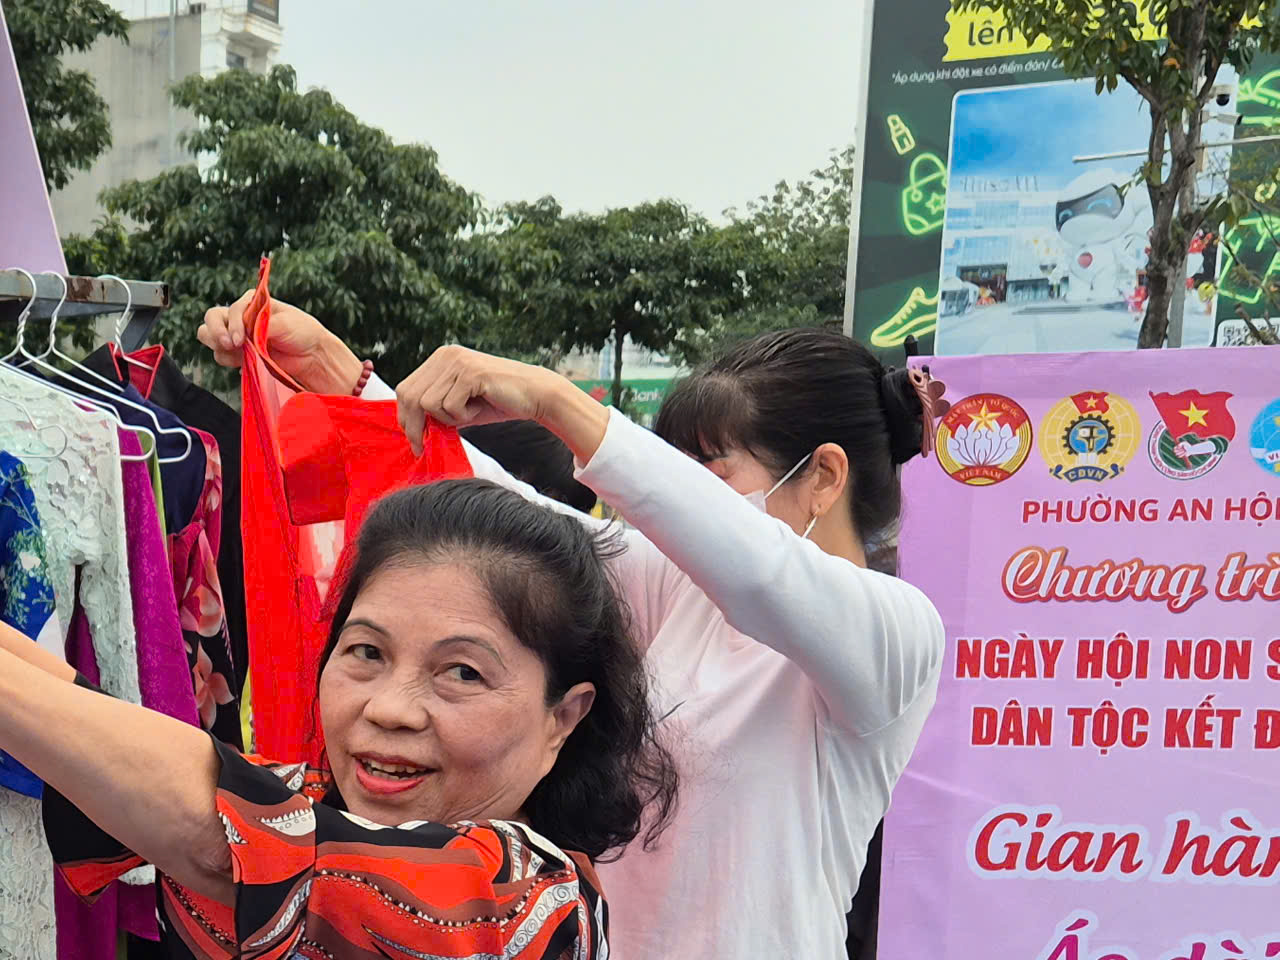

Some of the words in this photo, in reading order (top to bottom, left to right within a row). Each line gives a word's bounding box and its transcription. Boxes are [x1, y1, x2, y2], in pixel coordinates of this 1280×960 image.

[967, 20, 1014, 47] lên
[1022, 493, 1159, 523] PHƯỜNG
[1168, 498, 1213, 522] AN
[1003, 547, 1206, 613] Chương
[956, 633, 1064, 679] NGÀY
[1076, 632, 1150, 687] HỘI
[1164, 639, 1252, 680] NON
[972, 699, 1053, 746] DÂN
[1067, 700, 1149, 755] TỘC
[1164, 694, 1241, 749] KẾT
[975, 812, 1143, 874] Gian
